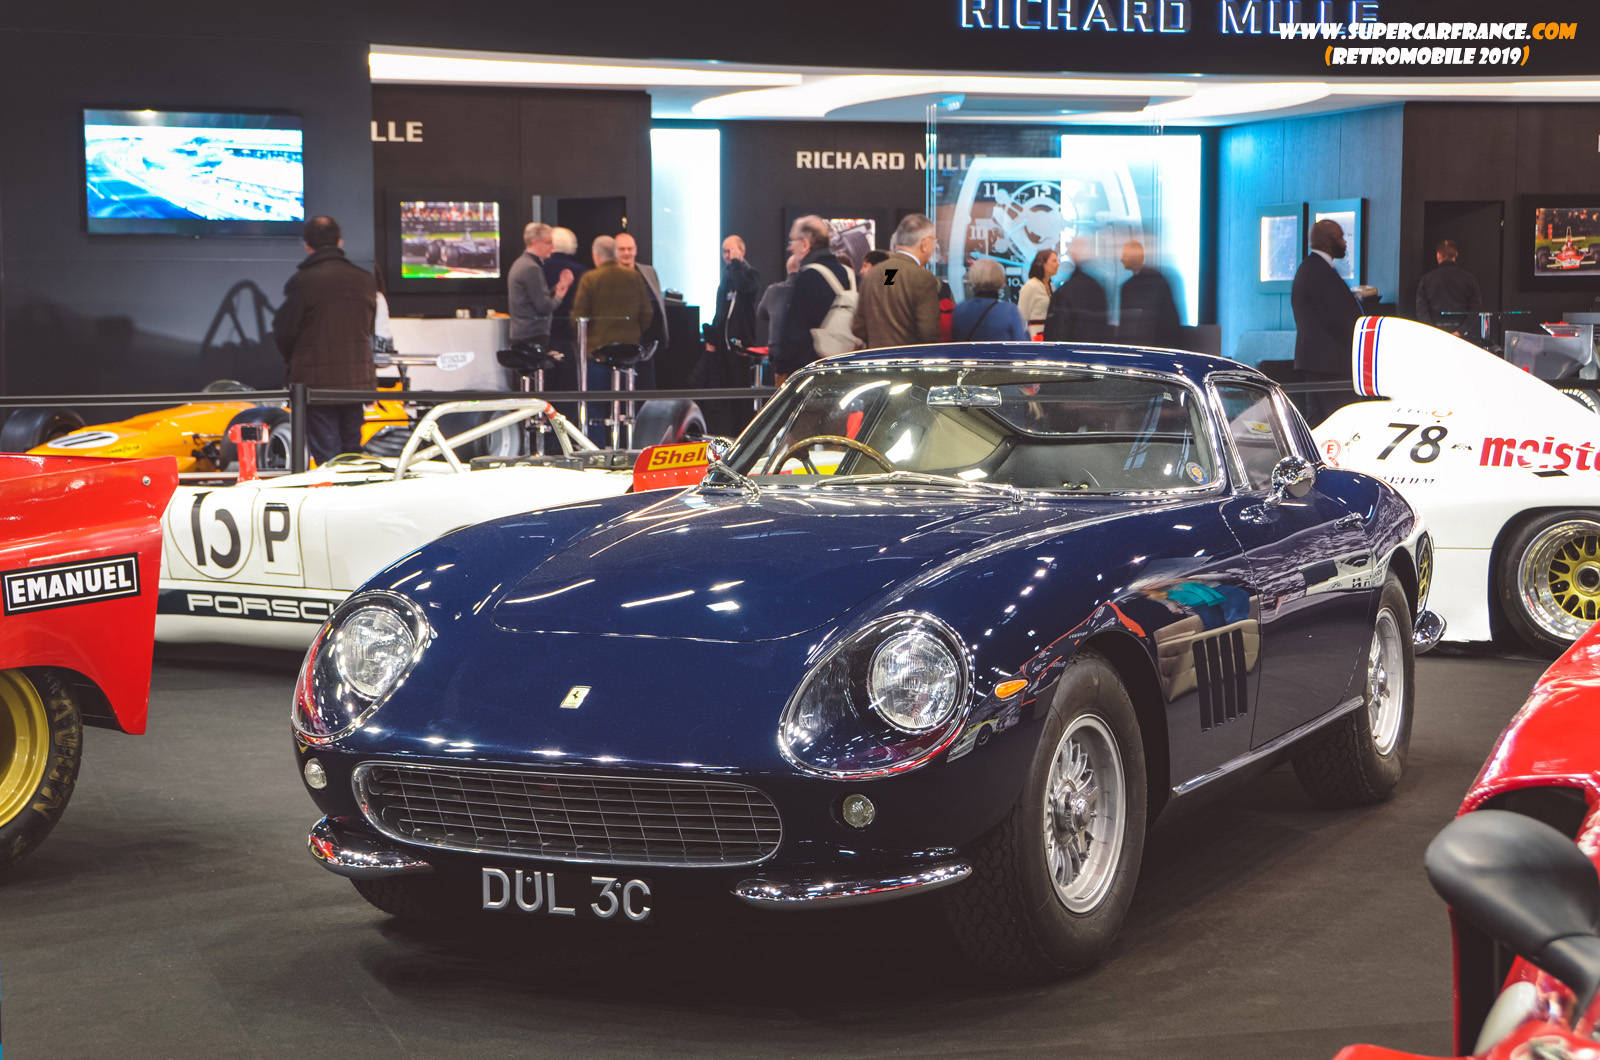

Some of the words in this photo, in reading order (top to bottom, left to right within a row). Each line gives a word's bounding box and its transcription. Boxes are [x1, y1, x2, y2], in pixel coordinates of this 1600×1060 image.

[961, 0, 1190, 34] RICHARD
[1221, 0, 1379, 35] MILLE
[796, 151, 905, 170] RICHARD
[914, 153, 987, 171] MILL
[1326, 444, 1335, 455] E
[1376, 422, 1448, 464] 78
[263, 502, 290, 562] P
[11, 565, 132, 604] EMANUEL
[482, 867, 576, 916] DUL
[591, 876, 651, 921] 3C
